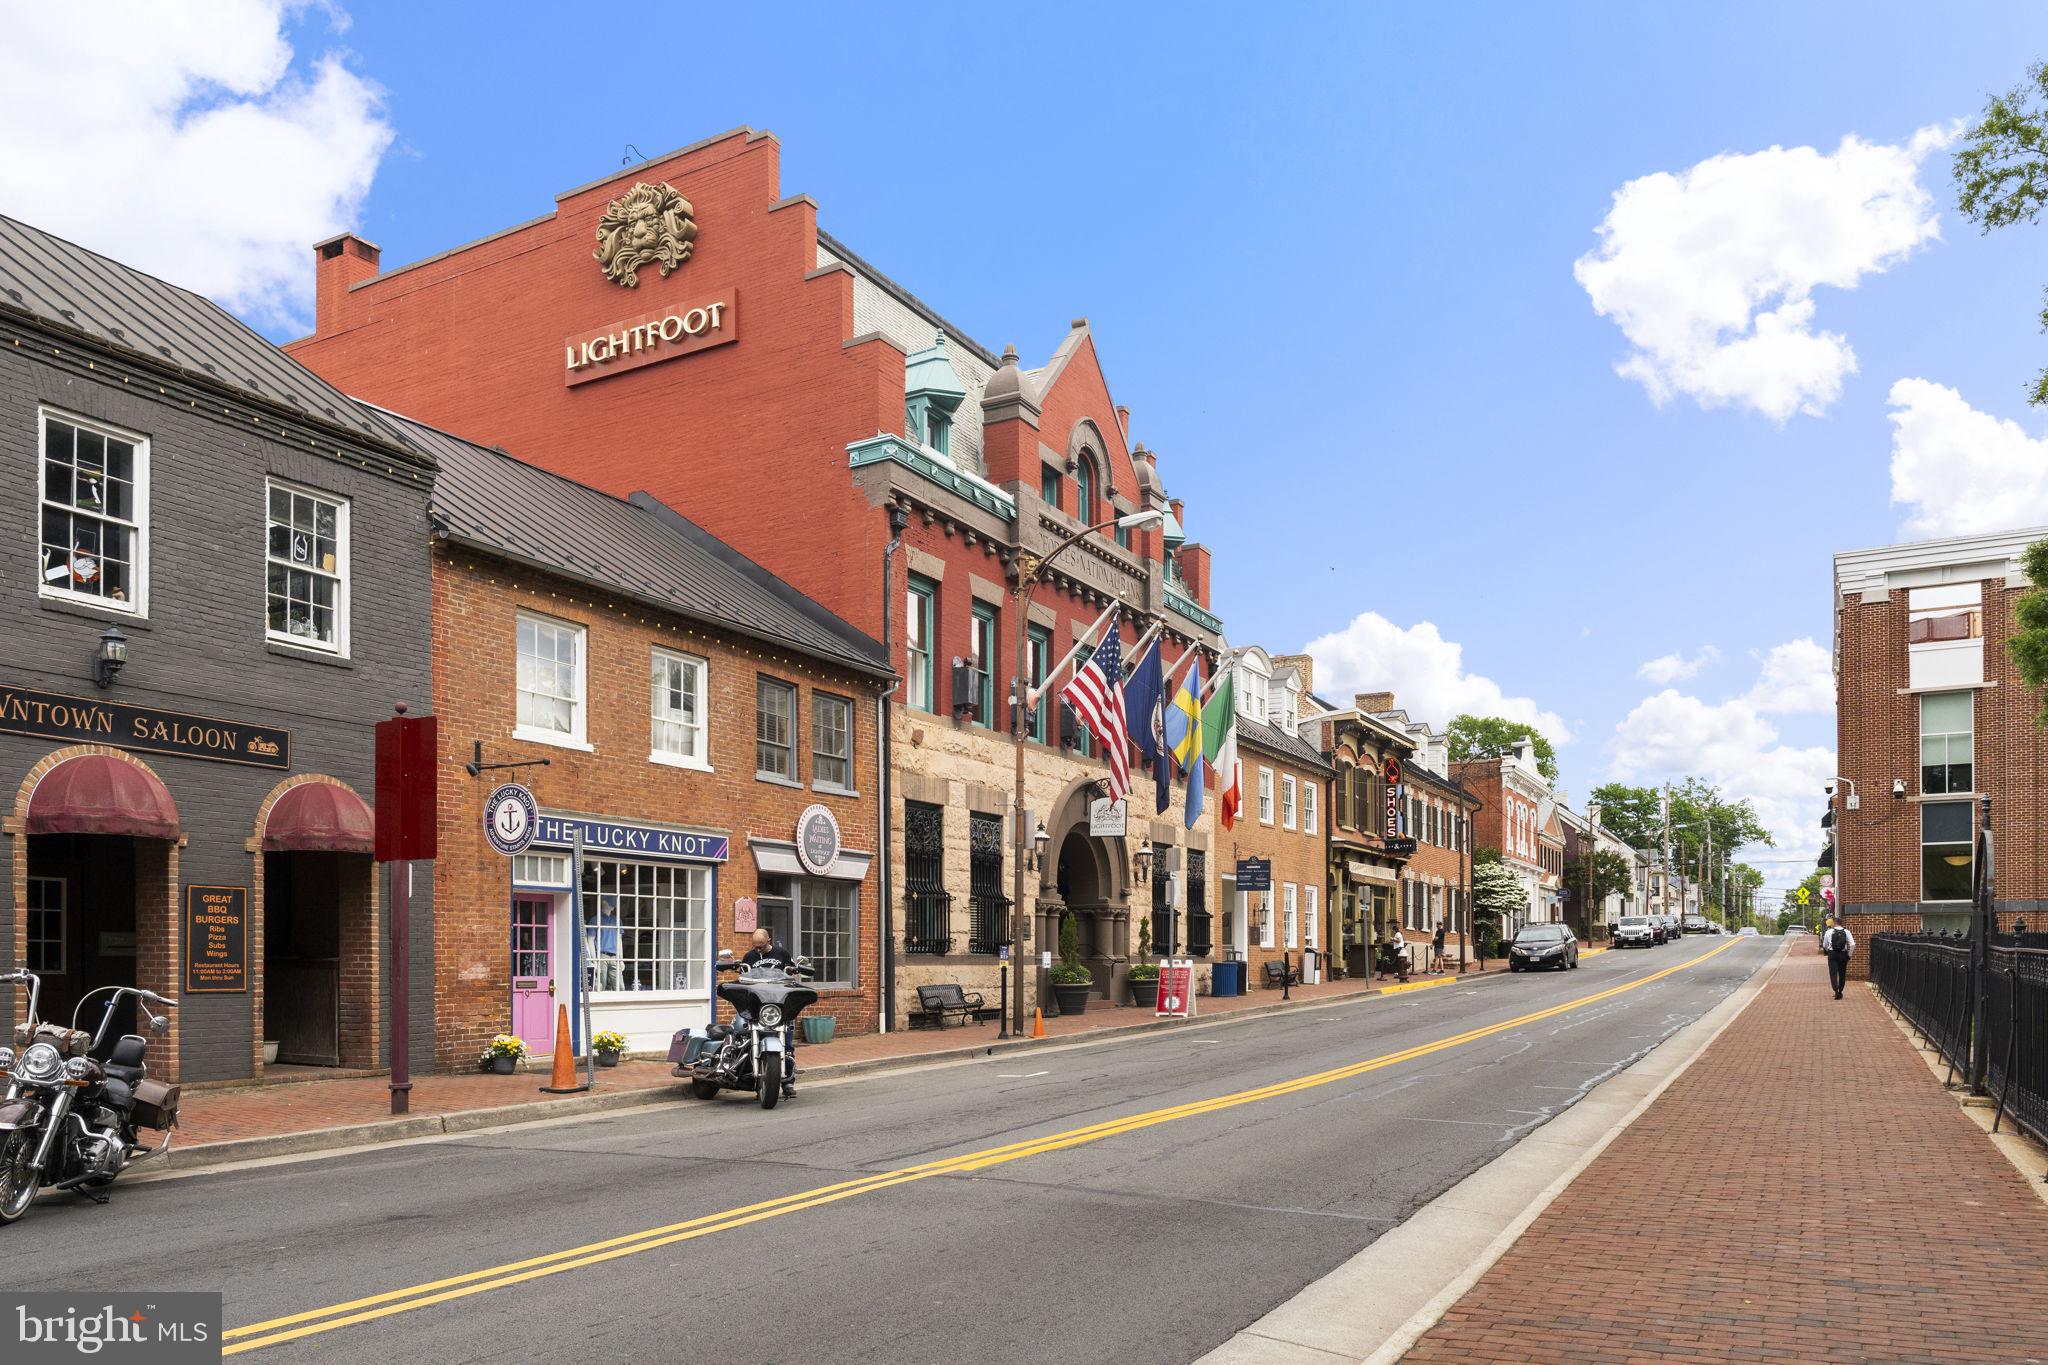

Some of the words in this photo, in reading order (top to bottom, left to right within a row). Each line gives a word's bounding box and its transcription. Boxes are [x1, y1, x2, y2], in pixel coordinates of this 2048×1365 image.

[567, 301, 726, 370] LIGHTFOOT
[1080, 555, 1119, 589] NATIONAL
[132, 717, 238, 751] SALOON
[1387, 787, 1396, 837] SHOES
[585, 825, 650, 849] LUCKY
[202, 895, 232, 903] GREAT
[207, 906, 227, 914] BBQ
[195, 915, 239, 924] BURGERS
[206, 950, 228, 958] Wings
